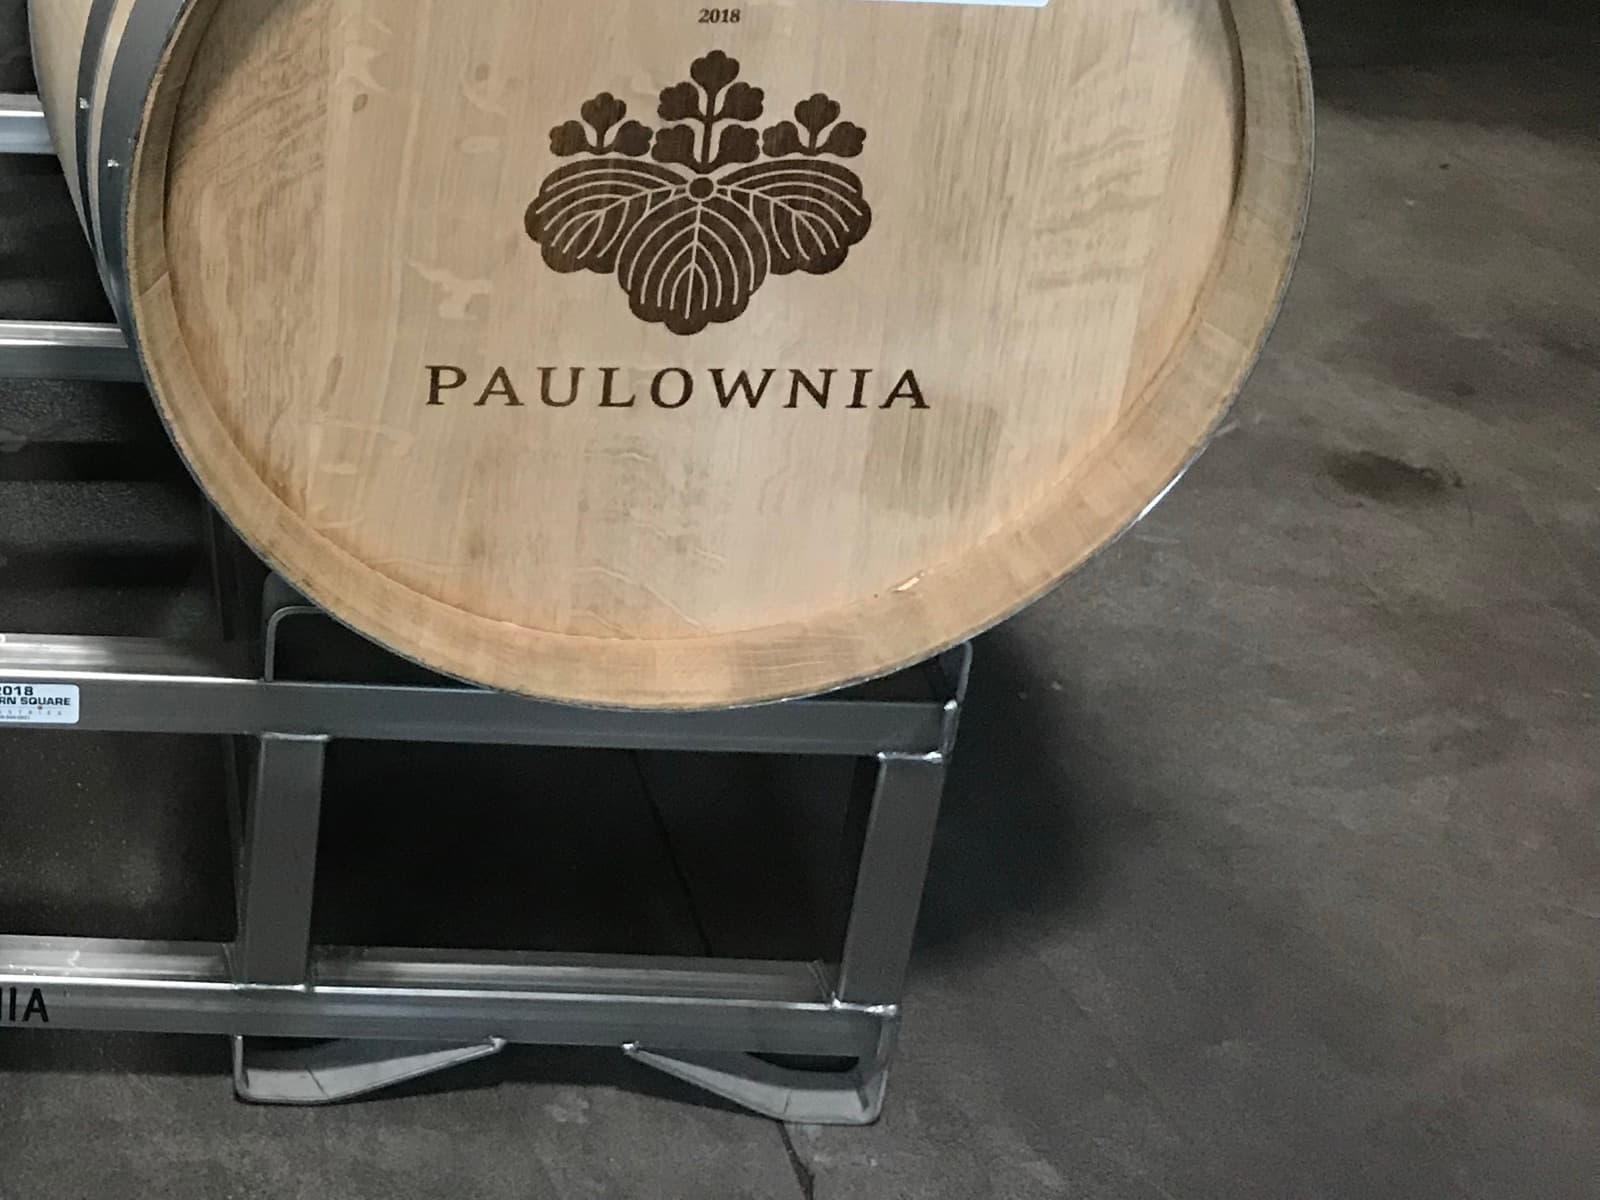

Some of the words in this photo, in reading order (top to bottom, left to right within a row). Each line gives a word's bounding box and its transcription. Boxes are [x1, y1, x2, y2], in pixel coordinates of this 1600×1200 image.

[697, 7, 742, 24] 2018
[423, 364, 931, 410] PAULOWNIA
[20, 696, 72, 706] SQUARE
